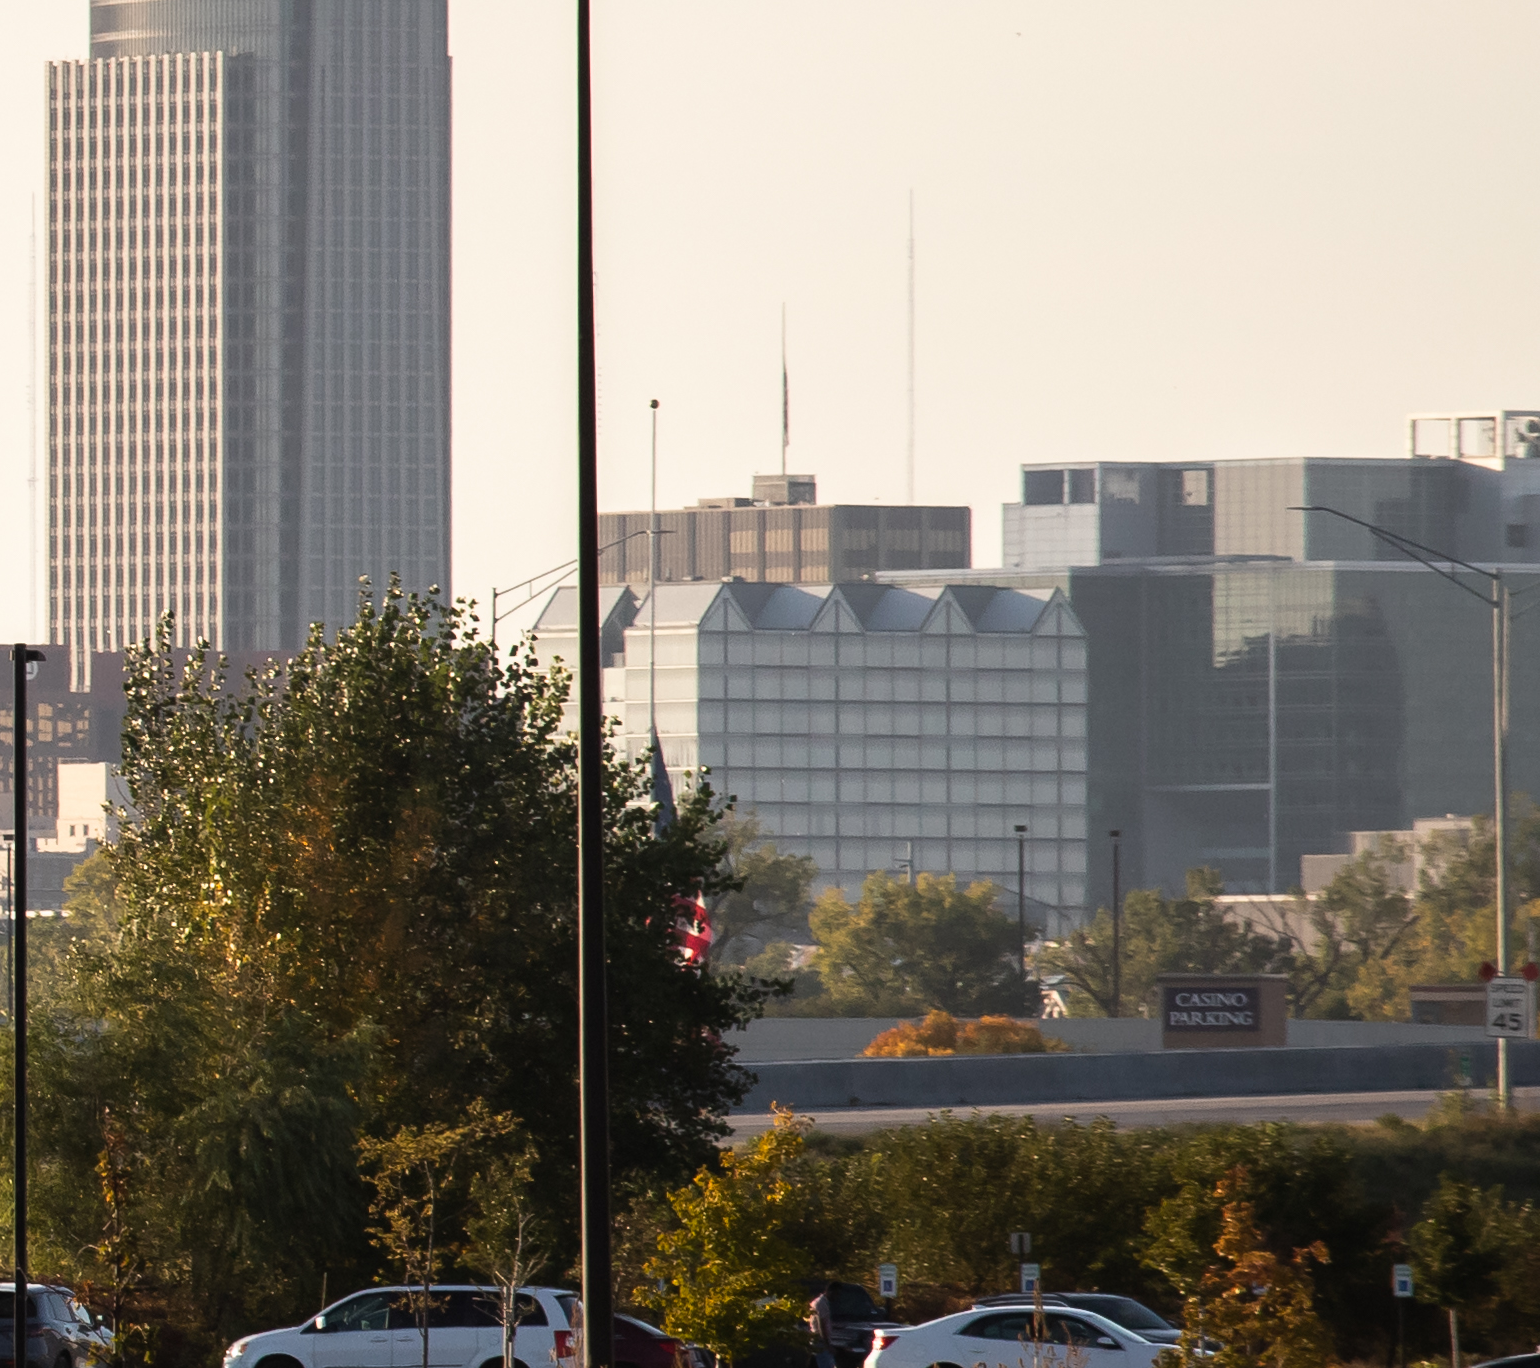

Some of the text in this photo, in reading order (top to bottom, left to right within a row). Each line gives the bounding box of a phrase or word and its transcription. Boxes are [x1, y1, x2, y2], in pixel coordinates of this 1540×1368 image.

[1175, 993, 1249, 1007] CASINO
[1170, 1012, 1253, 1026] PARKING
[1492, 1013, 1523, 1031] 45
